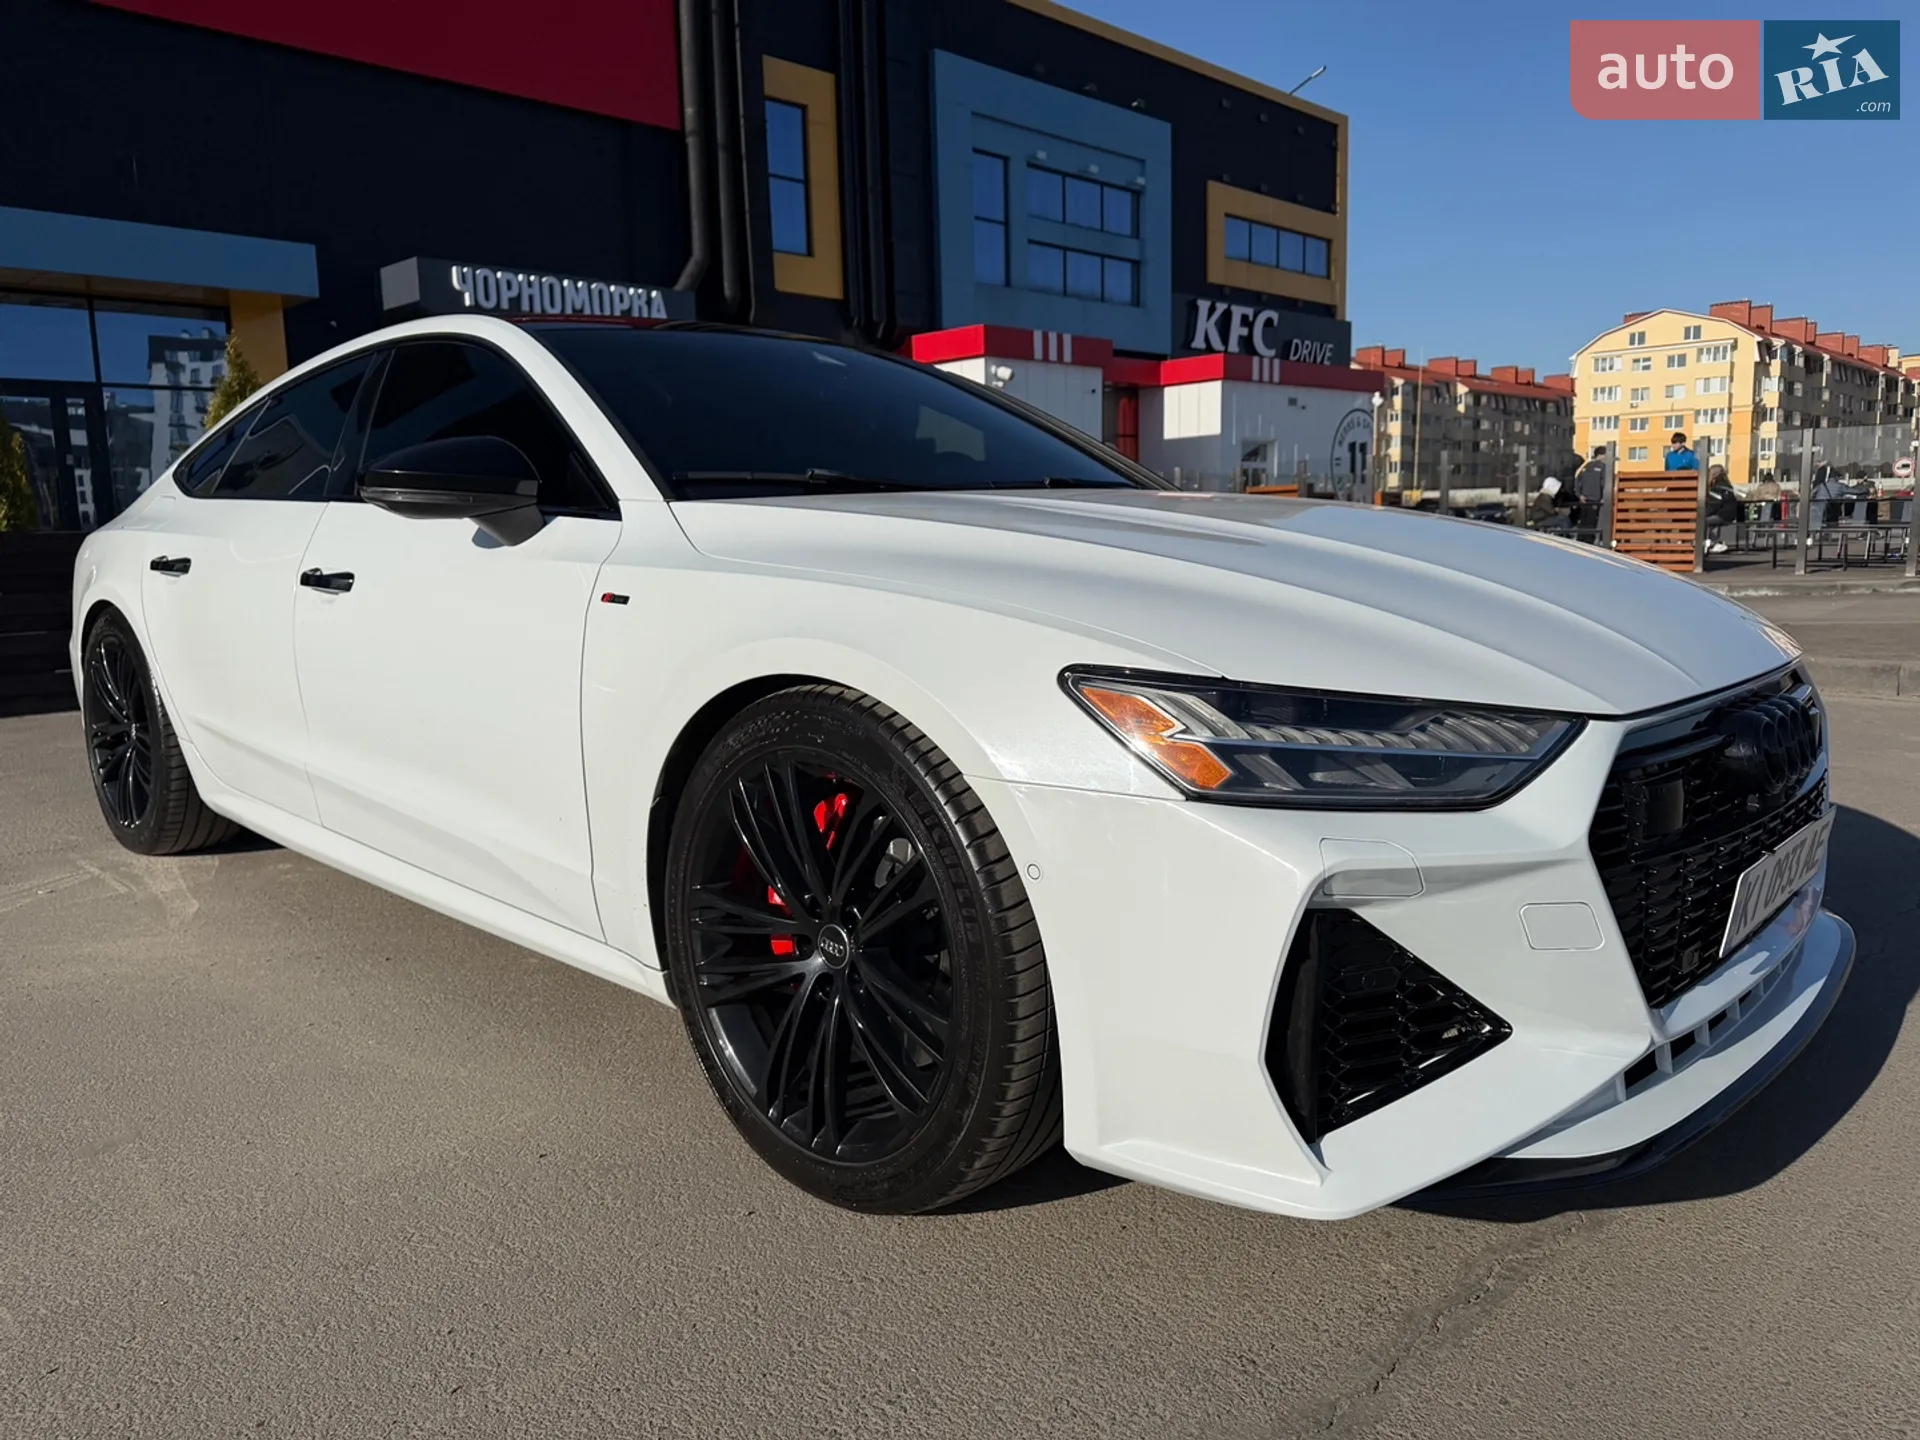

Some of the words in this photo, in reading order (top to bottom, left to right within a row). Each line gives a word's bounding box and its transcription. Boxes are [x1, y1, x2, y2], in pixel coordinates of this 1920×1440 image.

[451, 265, 668, 319] ЧОРНОМОРКА
[1191, 299, 1279, 356] KFC
[1289, 338, 1334, 366] DRIVE
